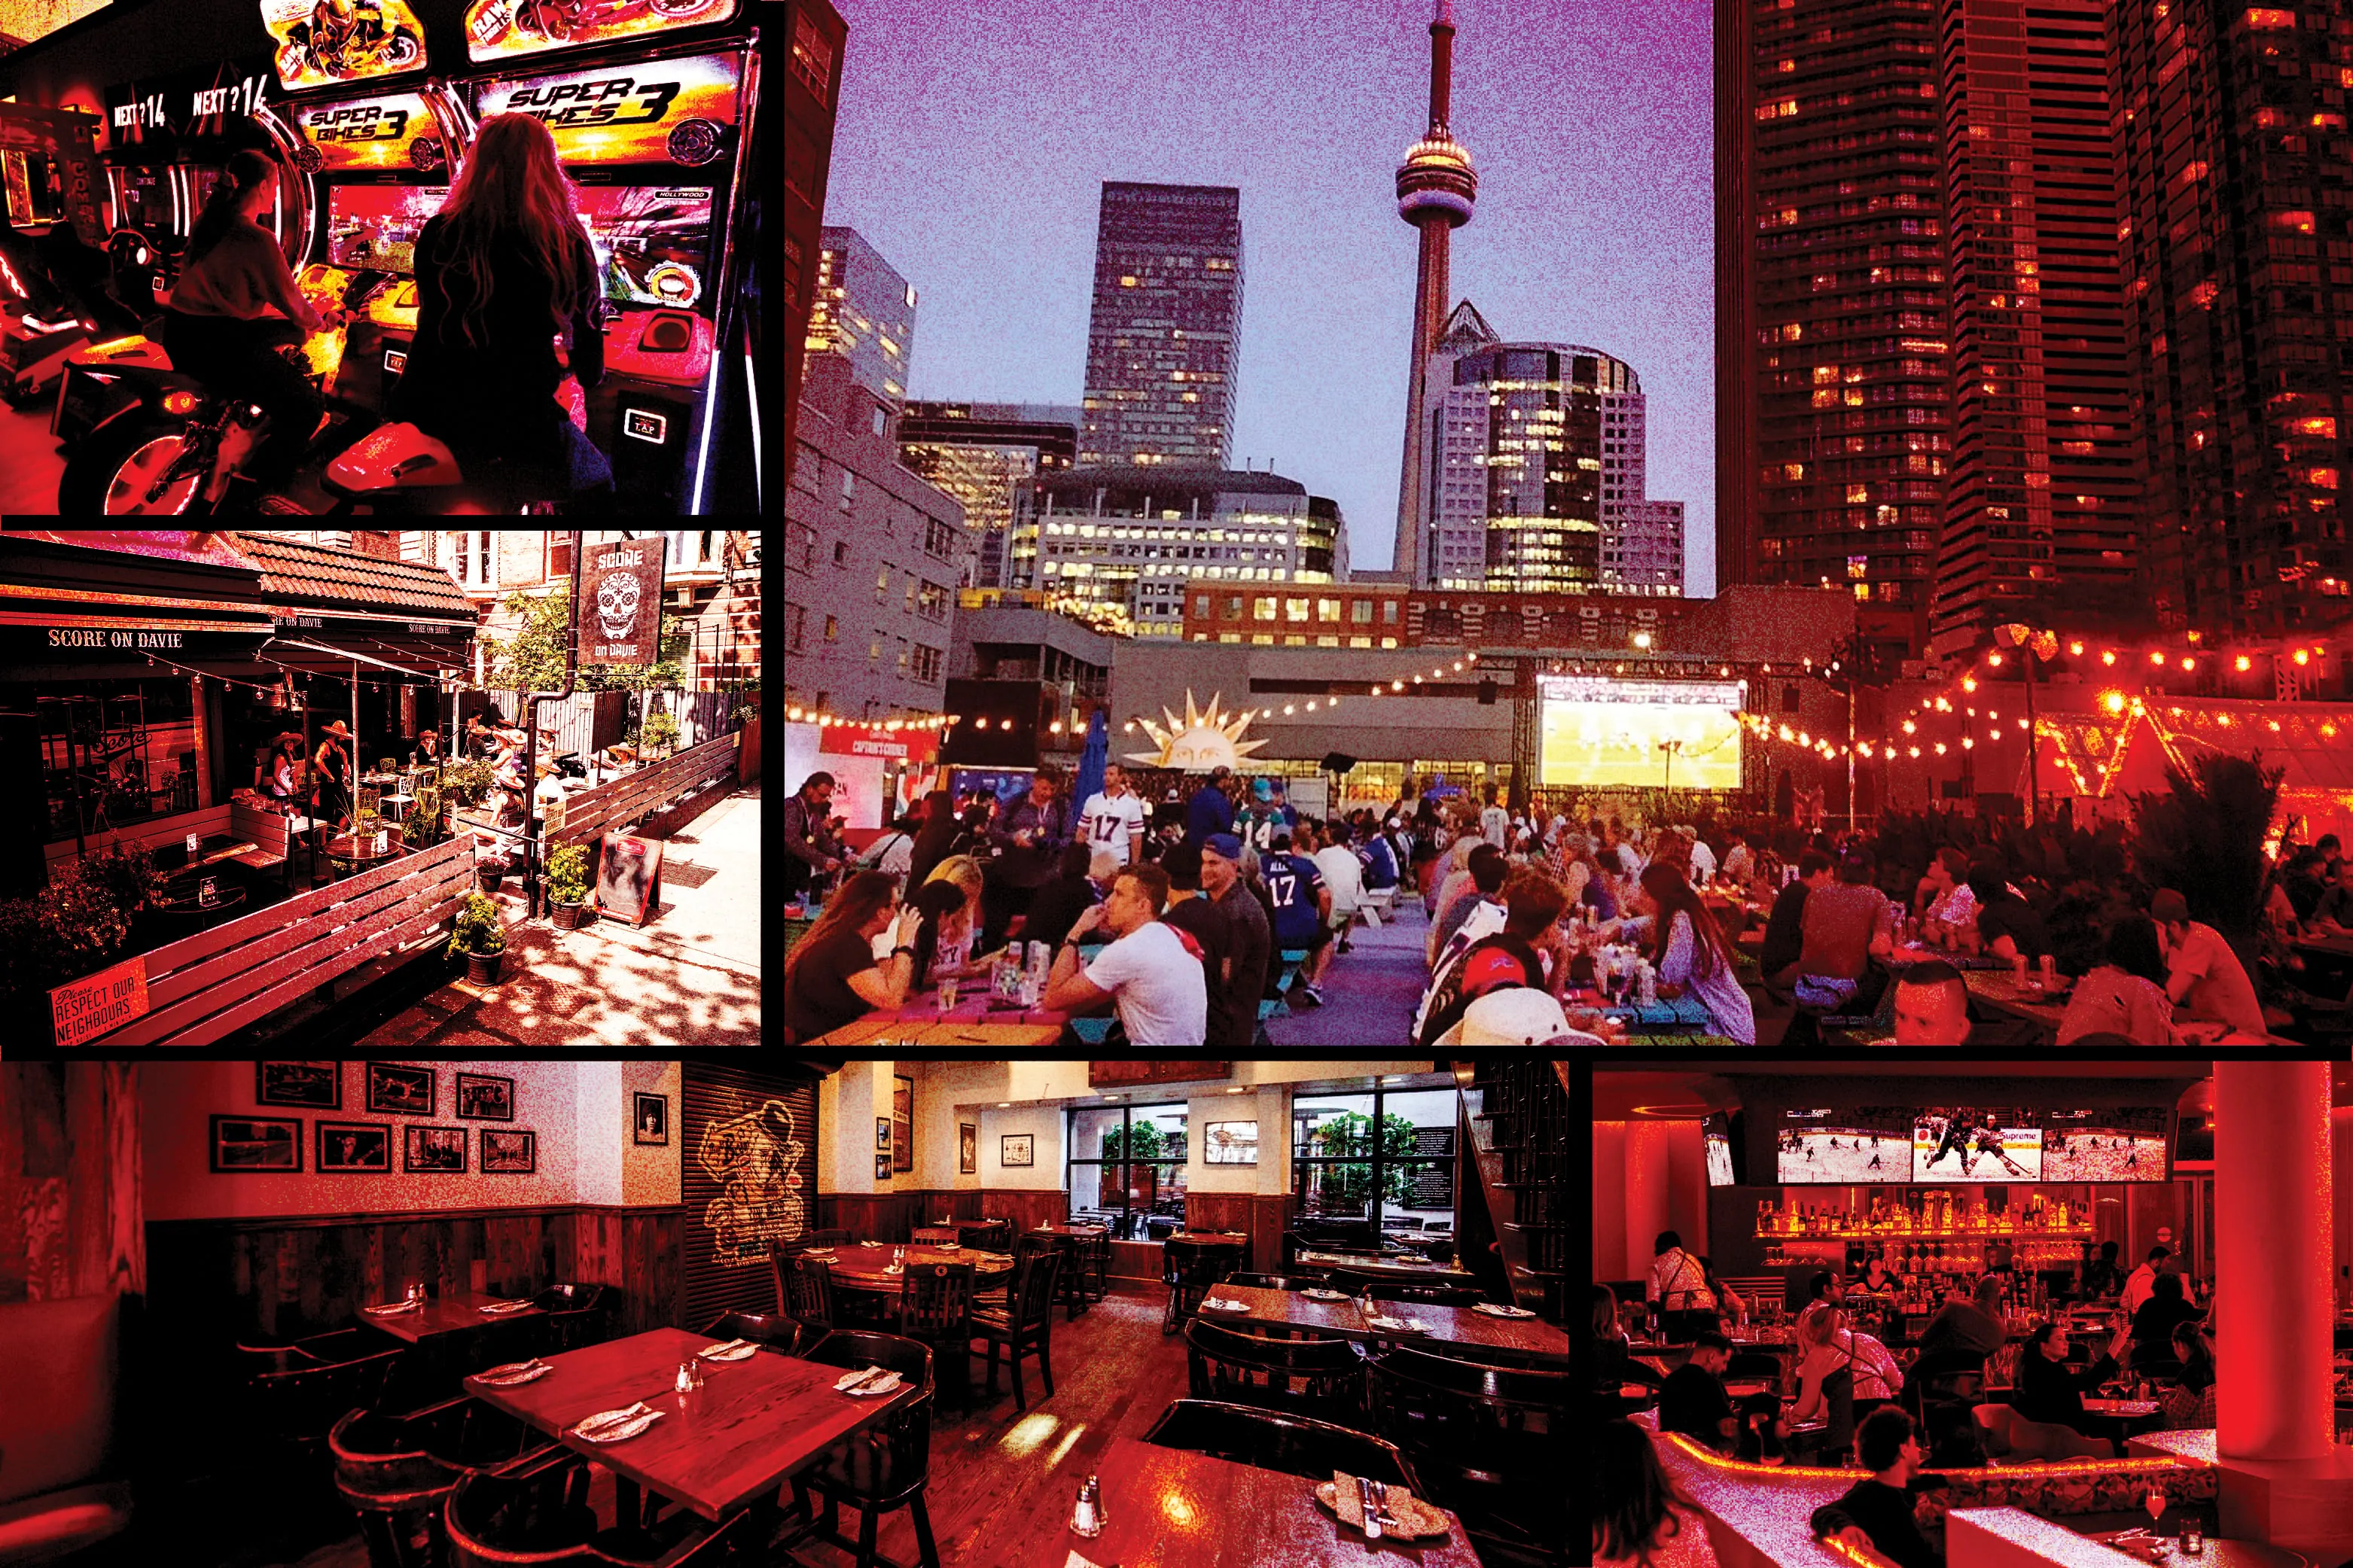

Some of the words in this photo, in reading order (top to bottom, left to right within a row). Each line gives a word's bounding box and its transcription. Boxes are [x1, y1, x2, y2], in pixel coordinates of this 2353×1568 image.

[193, 88, 227, 116] NEXT
[507, 78, 635, 108] SUPER
[635, 82, 681, 123] 3
[114, 104, 137, 127] NEXT
[147, 93, 165, 128] 14
[309, 106, 382, 126] SUPER
[526, 103, 621, 125] IKES
[316, 124, 377, 142] BIKES
[383, 110, 409, 139] 3
[635, 422, 655, 434] TAP
[598, 549, 643, 569] SCORE
[300, 617, 322, 628] DAVIE
[409, 623, 425, 633] SCORE
[48, 629, 107, 647] SCORE
[111, 632, 133, 647] ON
[138, 632, 182, 648] DAVIE
[595, 645, 607, 656] ON
[609, 643, 638, 657] DAVIE
[1095, 815, 1121, 842] 17
[1245, 821, 1271, 849] 14
[1269, 875, 1295, 907] 17
[56, 986, 93, 1005] Please
[56, 987, 107, 1023] RESPECT
[112, 976, 135, 999] OUR
[57, 998, 130, 1043] NEIGHBOURS
[2001, 1132, 2036, 1141] Supreme
